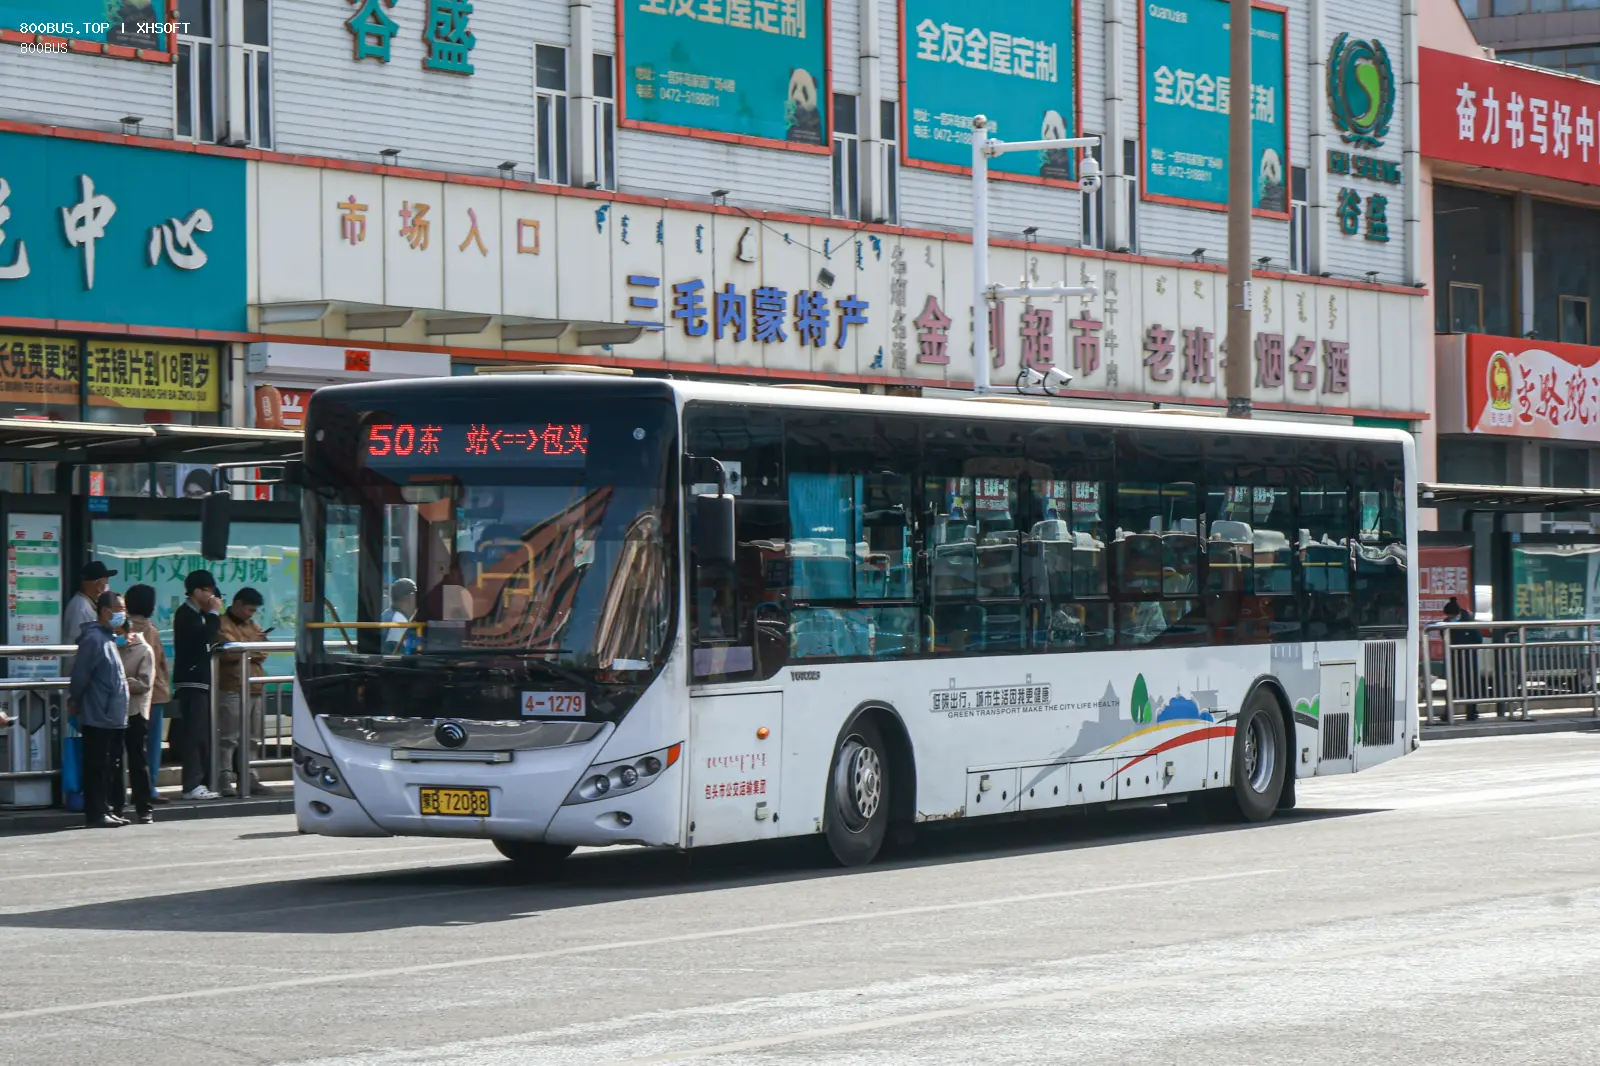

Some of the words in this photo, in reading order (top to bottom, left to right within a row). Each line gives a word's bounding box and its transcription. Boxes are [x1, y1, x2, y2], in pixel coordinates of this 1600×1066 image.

[916, 18, 1057, 83] 全友全屋定制
[1153, 65, 1275, 124] 全友全屋制
[1456, 82, 1600, 163] 奋力书写好中
[337, 194, 541, 257] 市场入口
[625, 275, 869, 350] 三毛内蒙特产
[1143, 323, 1350, 395] 老班烟名酒
[368, 424, 415, 456] 50
[525, 695, 583, 713] 4-1279
[947, 710, 975, 719] GREEN
[976, 707, 1021, 717] TRANSPORT
[1022, 705, 1043, 714] MAKE
[1044, 704, 1058, 712] THE
[1059, 703, 1075, 711] CITY
[1076, 702, 1092, 710] LIFE
[1092, 700, 1120, 709] HEALTH
